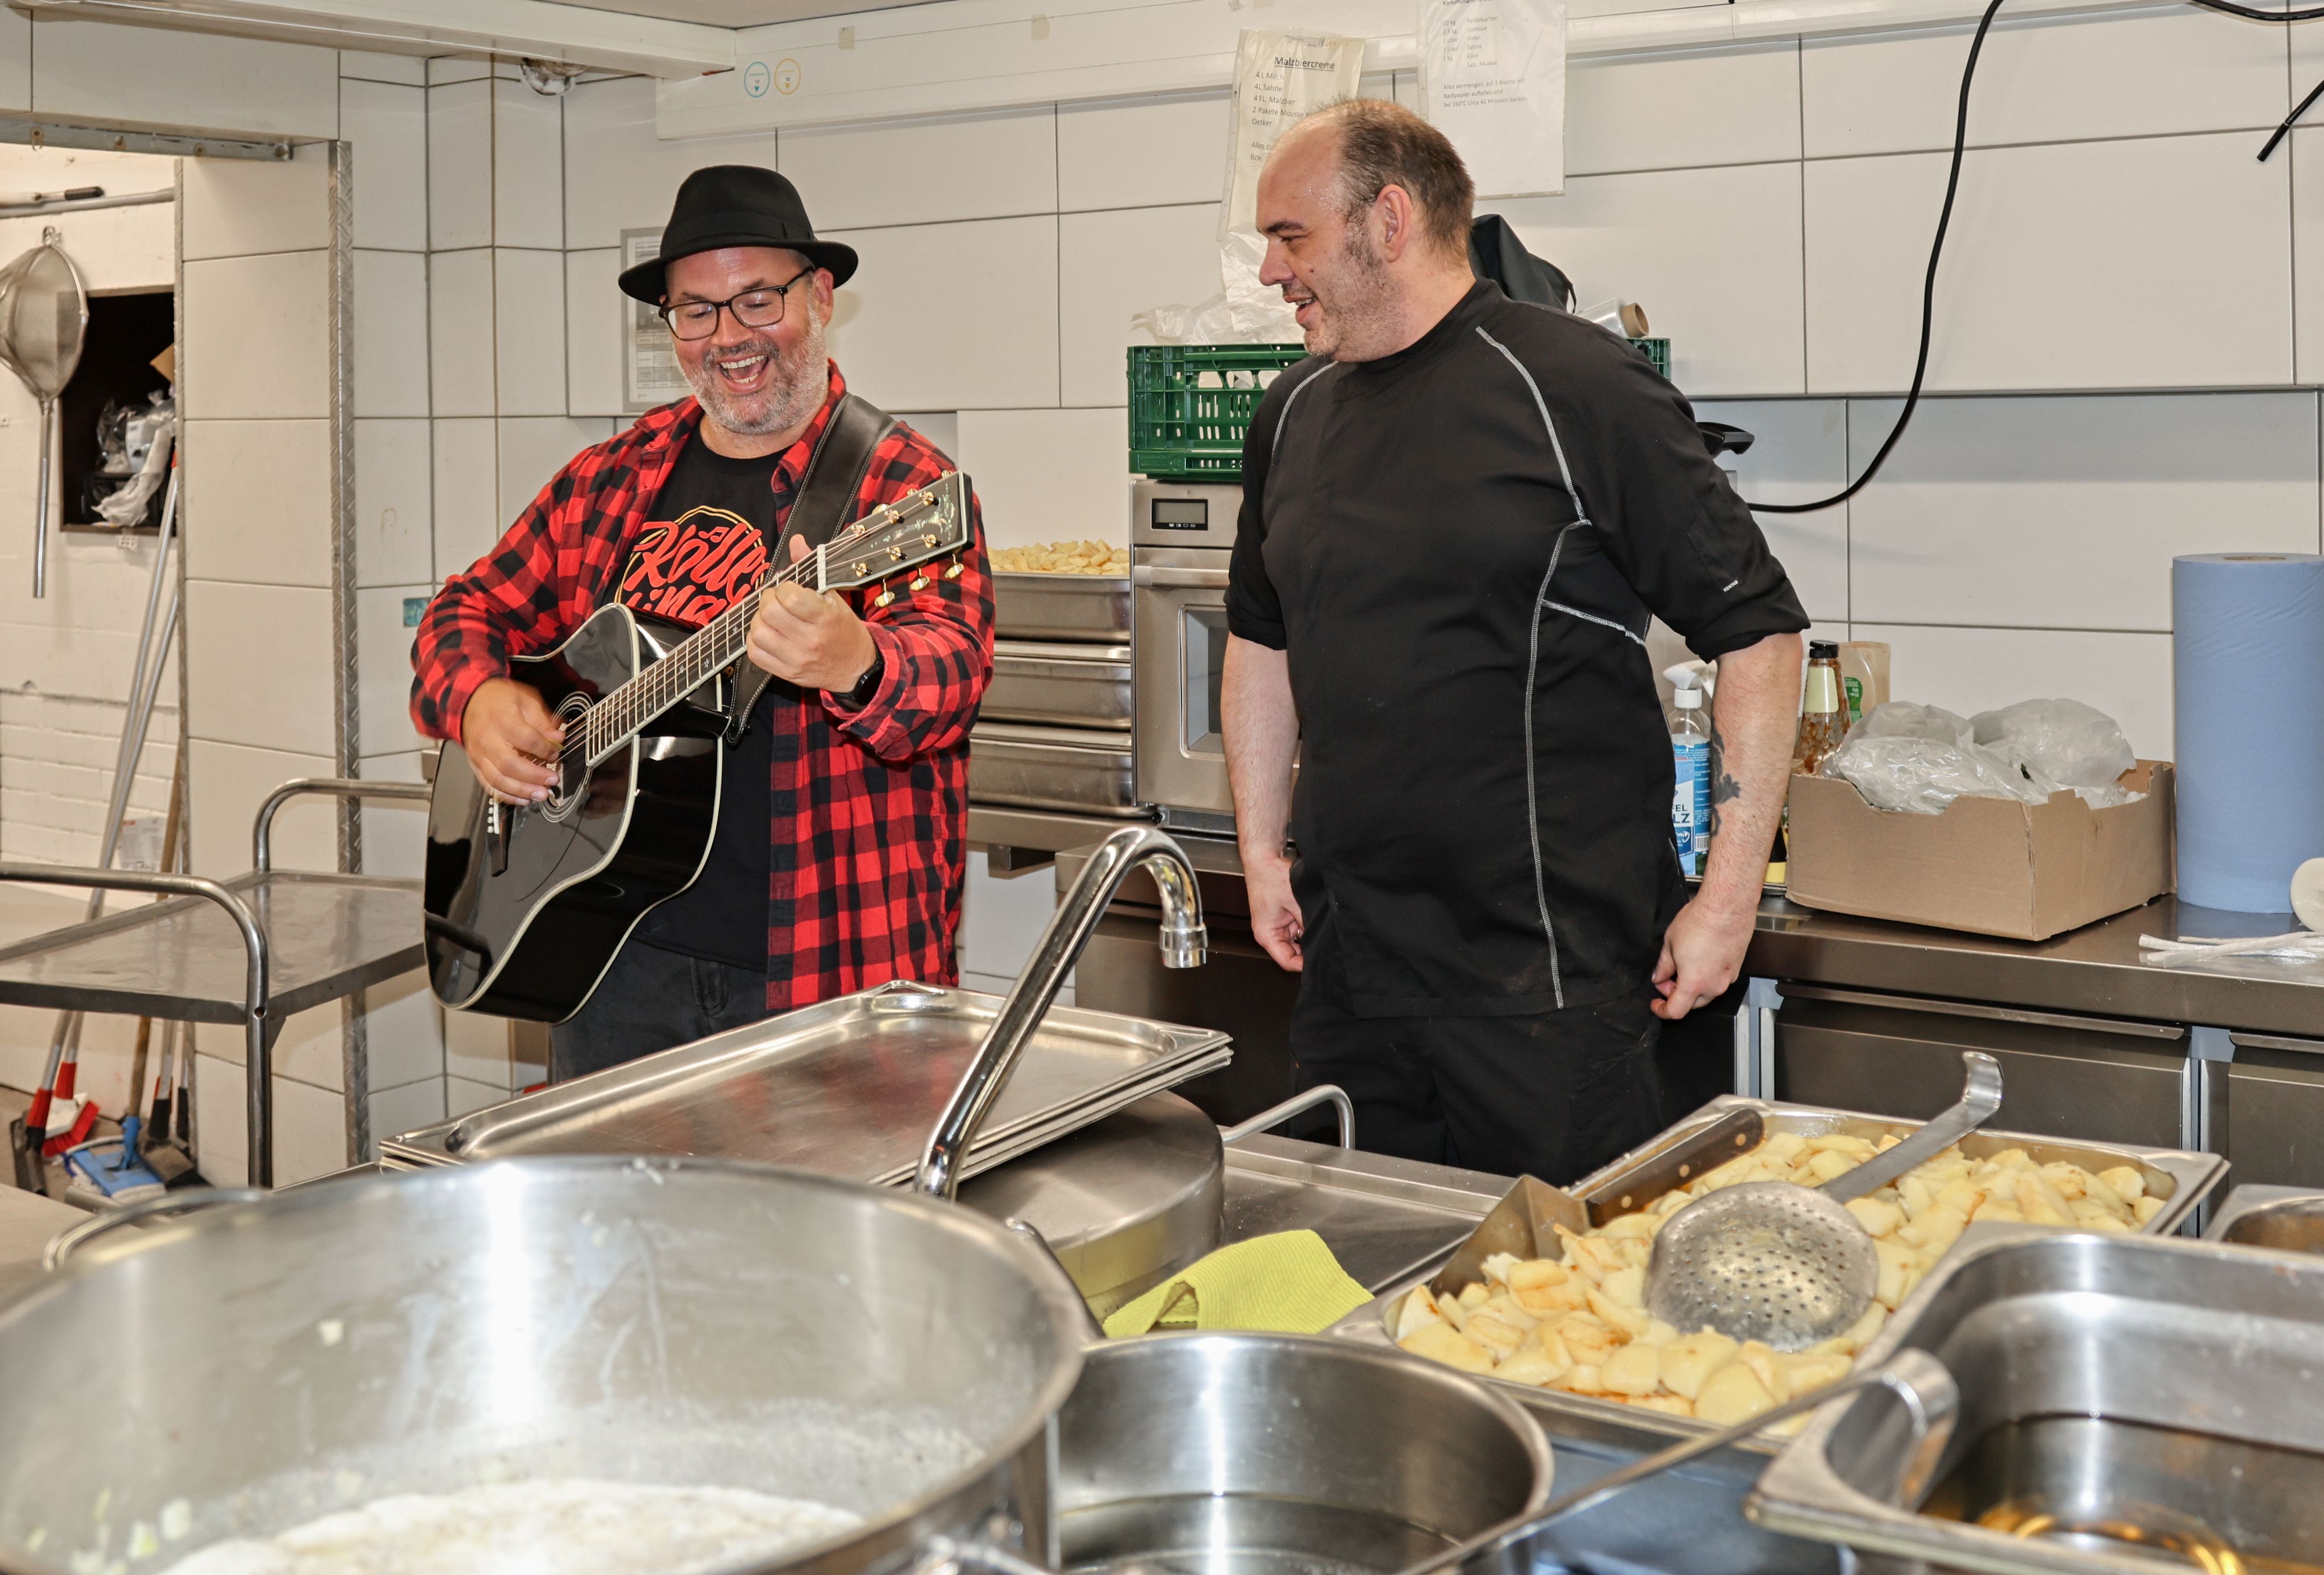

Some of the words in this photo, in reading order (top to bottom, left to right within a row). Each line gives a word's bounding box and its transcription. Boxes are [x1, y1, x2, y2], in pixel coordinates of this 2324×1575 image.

[1274, 56, 1335, 69] Malzbiercreme
[1263, 84, 1283, 92] Sahne
[1269, 96, 1296, 105] Malzbier
[1258, 107, 1278, 115] Pakete
[1281, 109, 1304, 117] Mousse
[1252, 118, 1272, 126] Oetker
[1251, 141, 1264, 149] Alles
